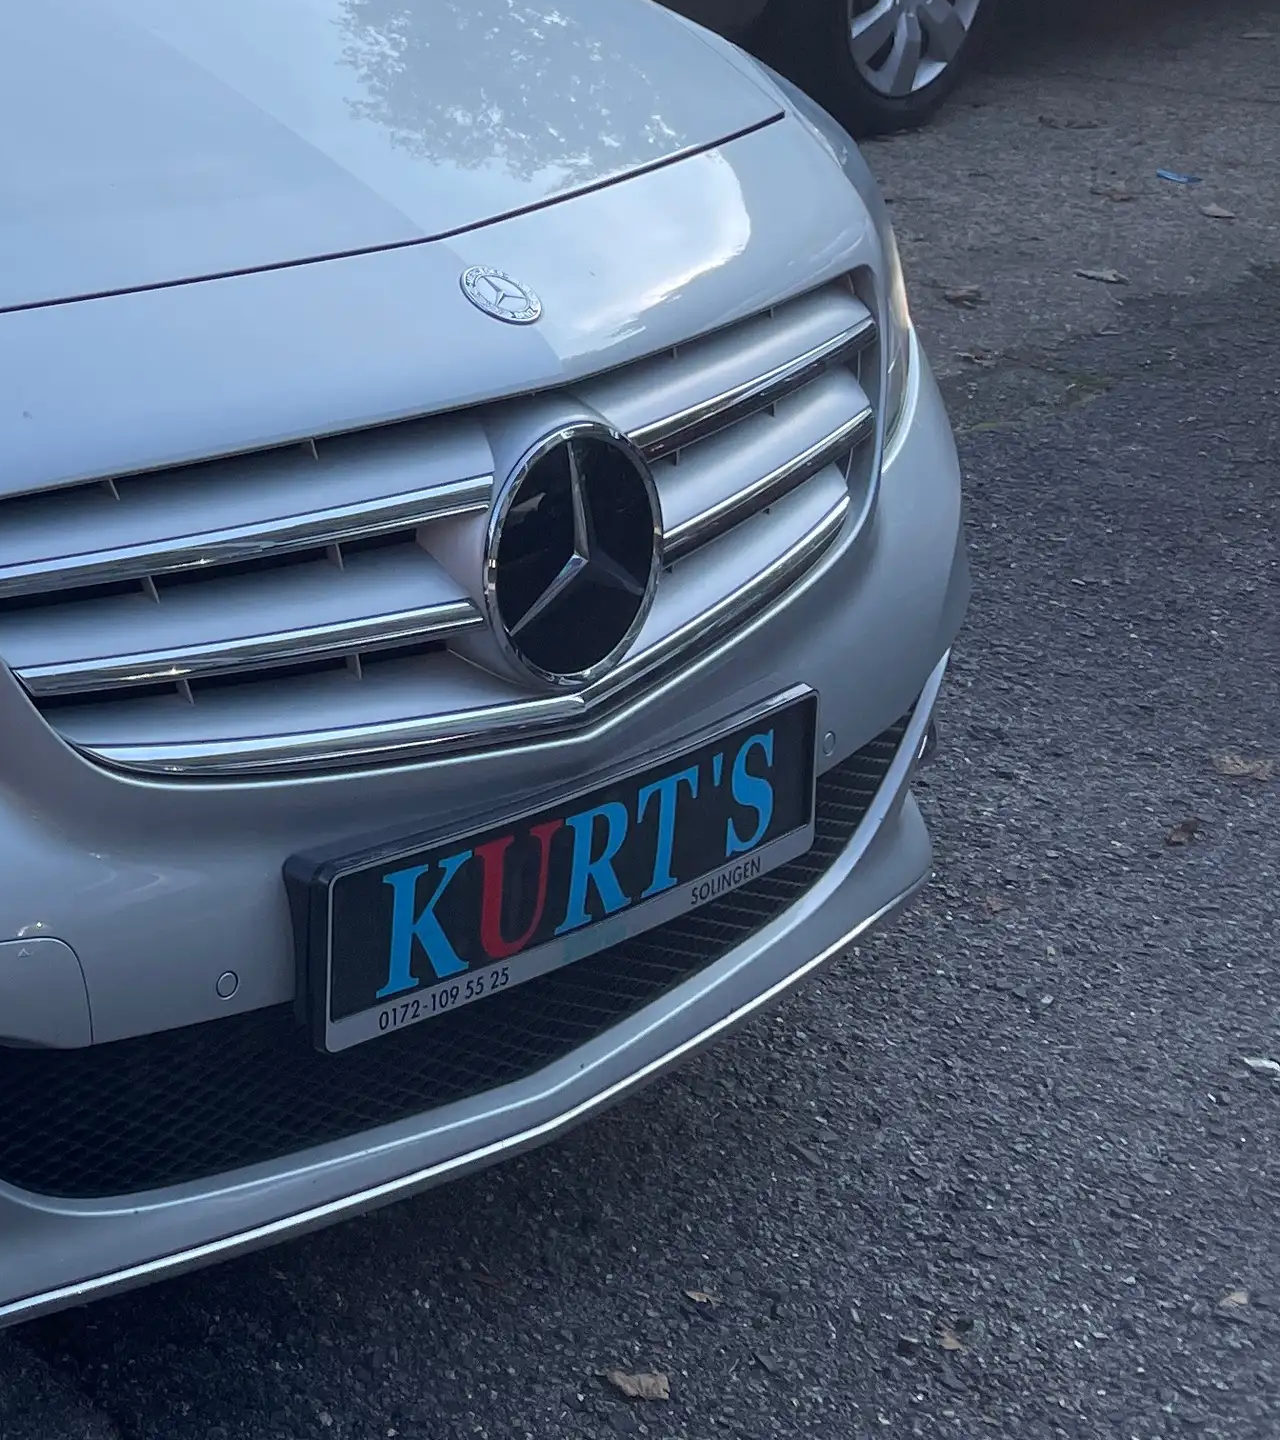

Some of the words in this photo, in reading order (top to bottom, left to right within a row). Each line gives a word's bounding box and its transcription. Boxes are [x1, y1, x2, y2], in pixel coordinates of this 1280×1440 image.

[376, 729, 775, 999] KURT'S
[691, 856, 761, 905] SOLINGEN
[379, 986, 459, 1030] 0172-109
[465, 976, 484, 999] 55
[490, 967, 510, 990] 25
